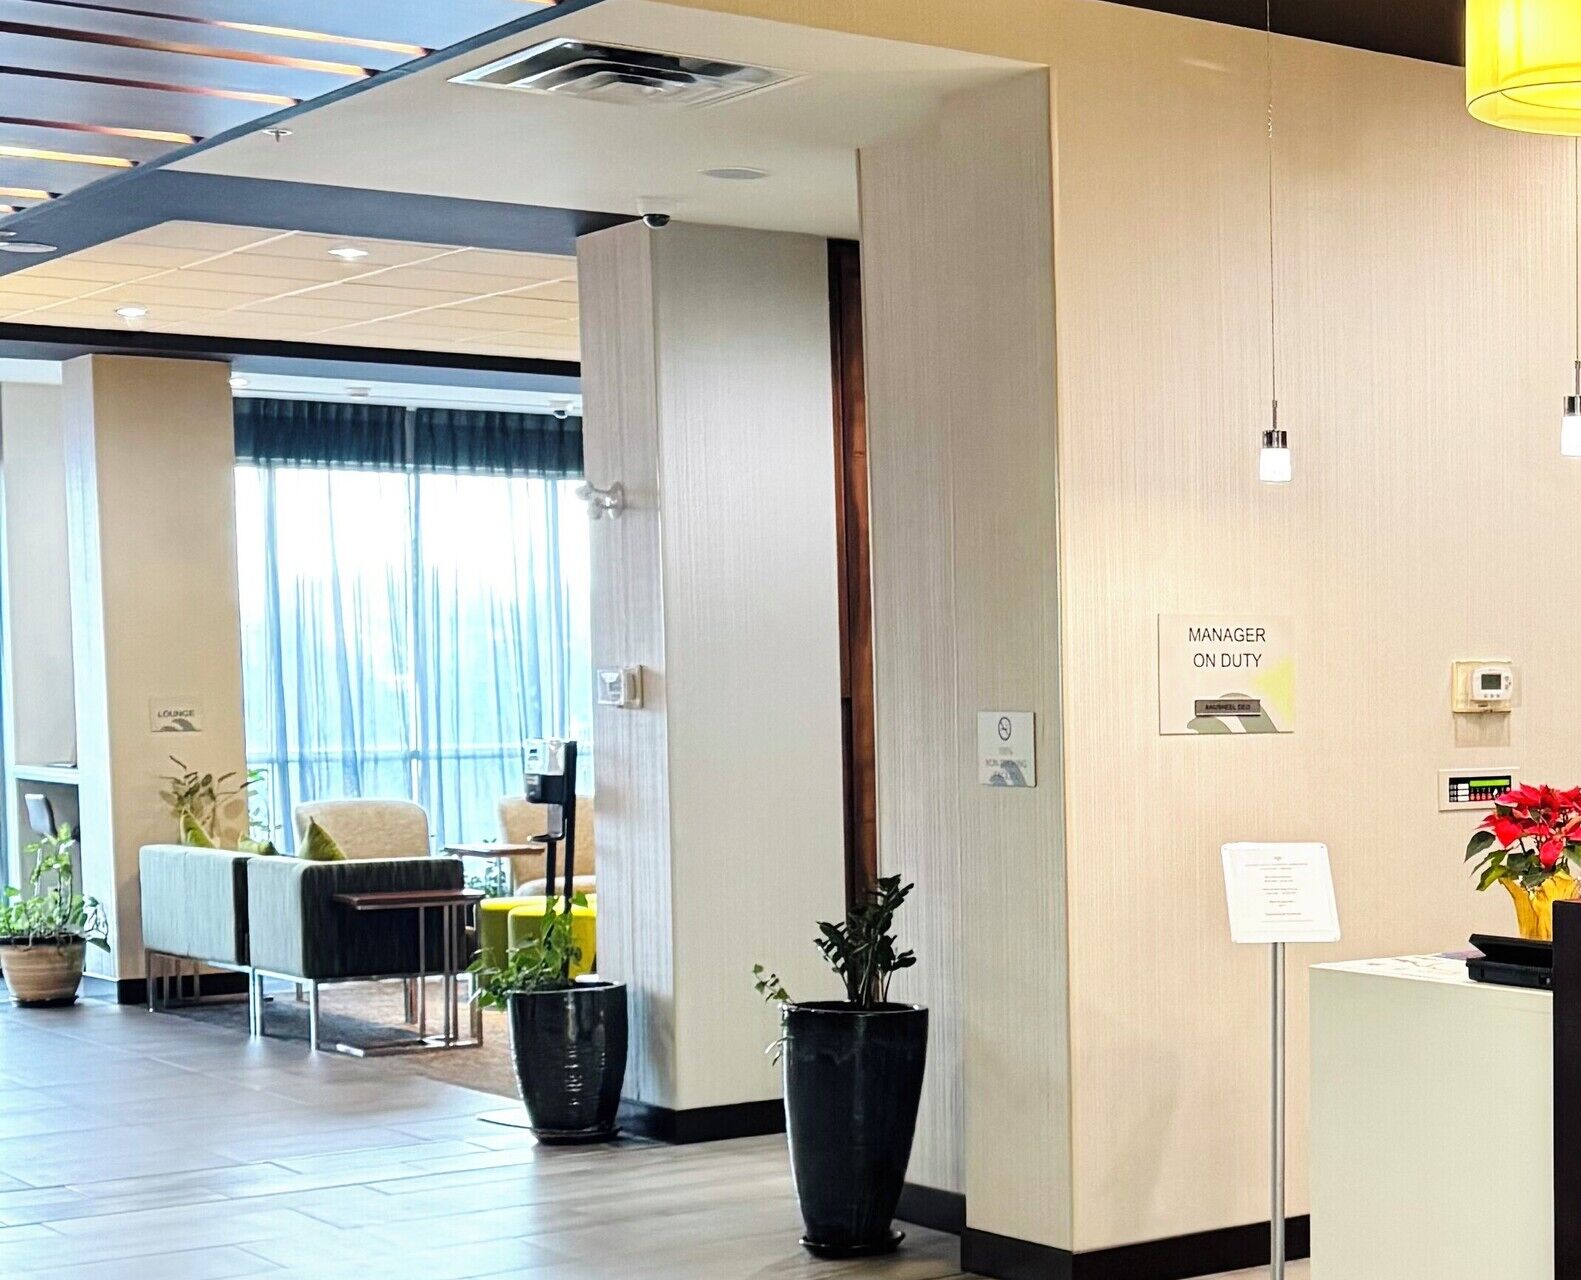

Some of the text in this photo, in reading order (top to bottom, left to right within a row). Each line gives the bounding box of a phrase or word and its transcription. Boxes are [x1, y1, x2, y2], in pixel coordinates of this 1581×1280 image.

[1188, 627, 1266, 642] MANAGER
[1193, 653, 1262, 668] ON DUTY
